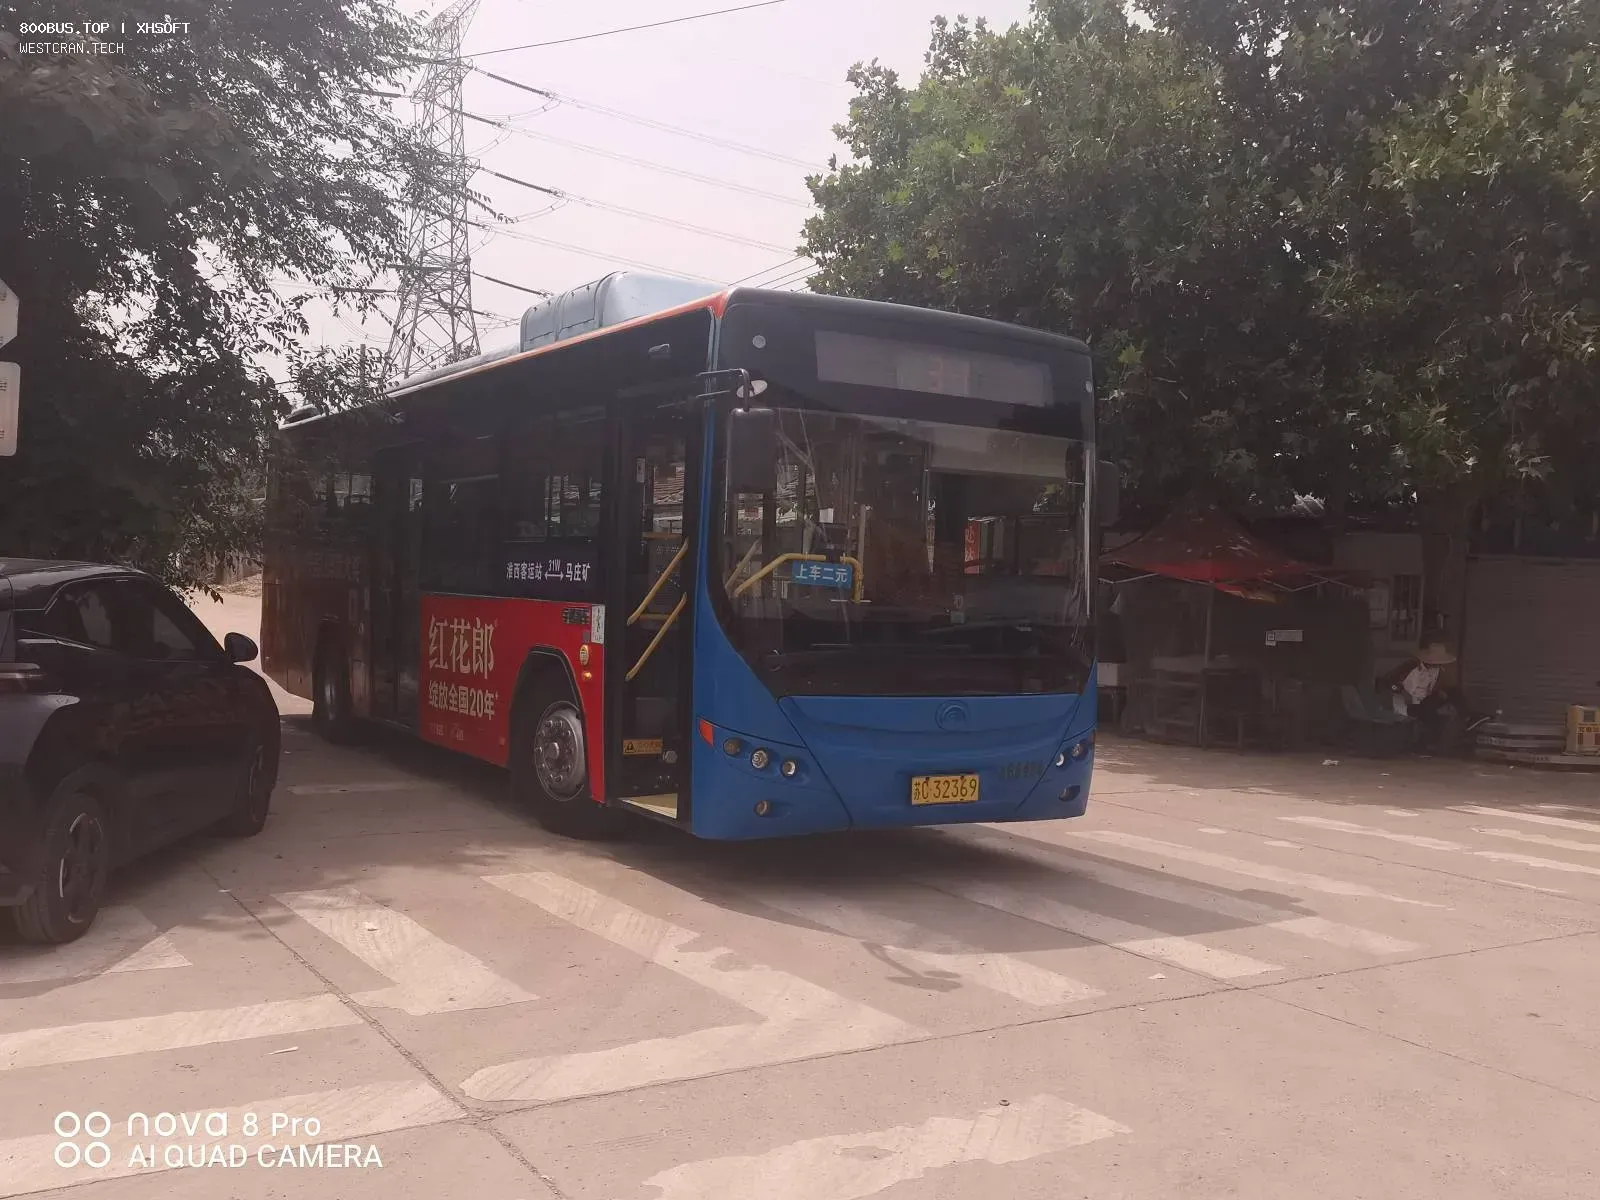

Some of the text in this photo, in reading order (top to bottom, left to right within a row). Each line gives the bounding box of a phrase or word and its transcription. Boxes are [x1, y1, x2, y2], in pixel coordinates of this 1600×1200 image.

[506, 561, 591, 583] 淮西客运站 马庄矿
[795, 563, 848, 583] 上车二元
[428, 614, 495, 680] 红花郎
